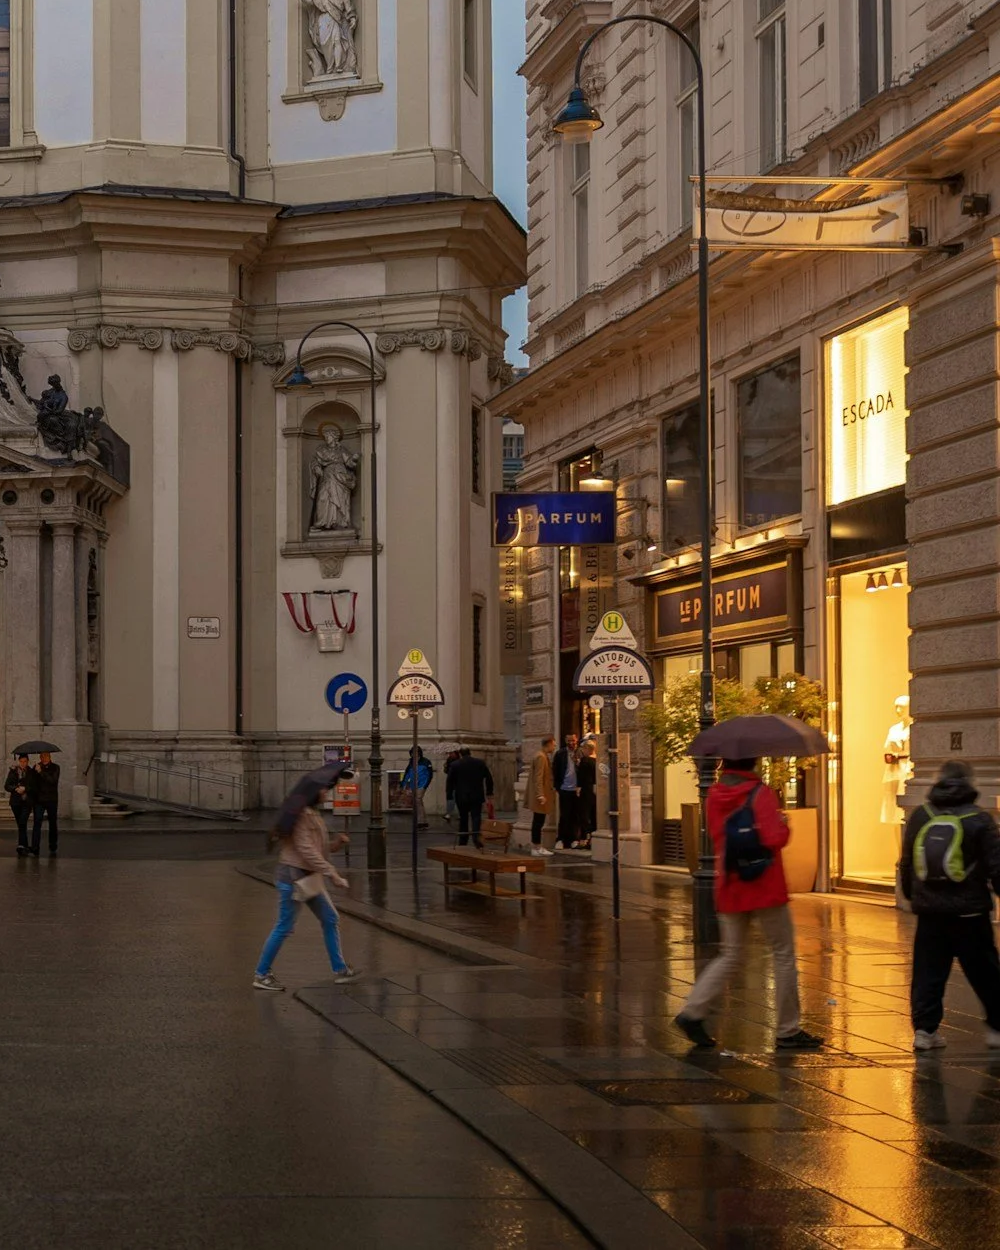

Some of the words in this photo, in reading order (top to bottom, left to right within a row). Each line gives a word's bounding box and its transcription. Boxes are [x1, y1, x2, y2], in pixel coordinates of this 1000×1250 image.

[843, 391, 894, 426] ESCADA
[525, 512, 602, 524] PARFUM
[680, 600, 691, 616] LE
[693, 584, 760, 620] PRFUM
[593, 652, 637, 668] AUTOBUS
[401, 678, 432, 690] AUTOBUS
[585, 675, 644, 684] HALTESTELLE
